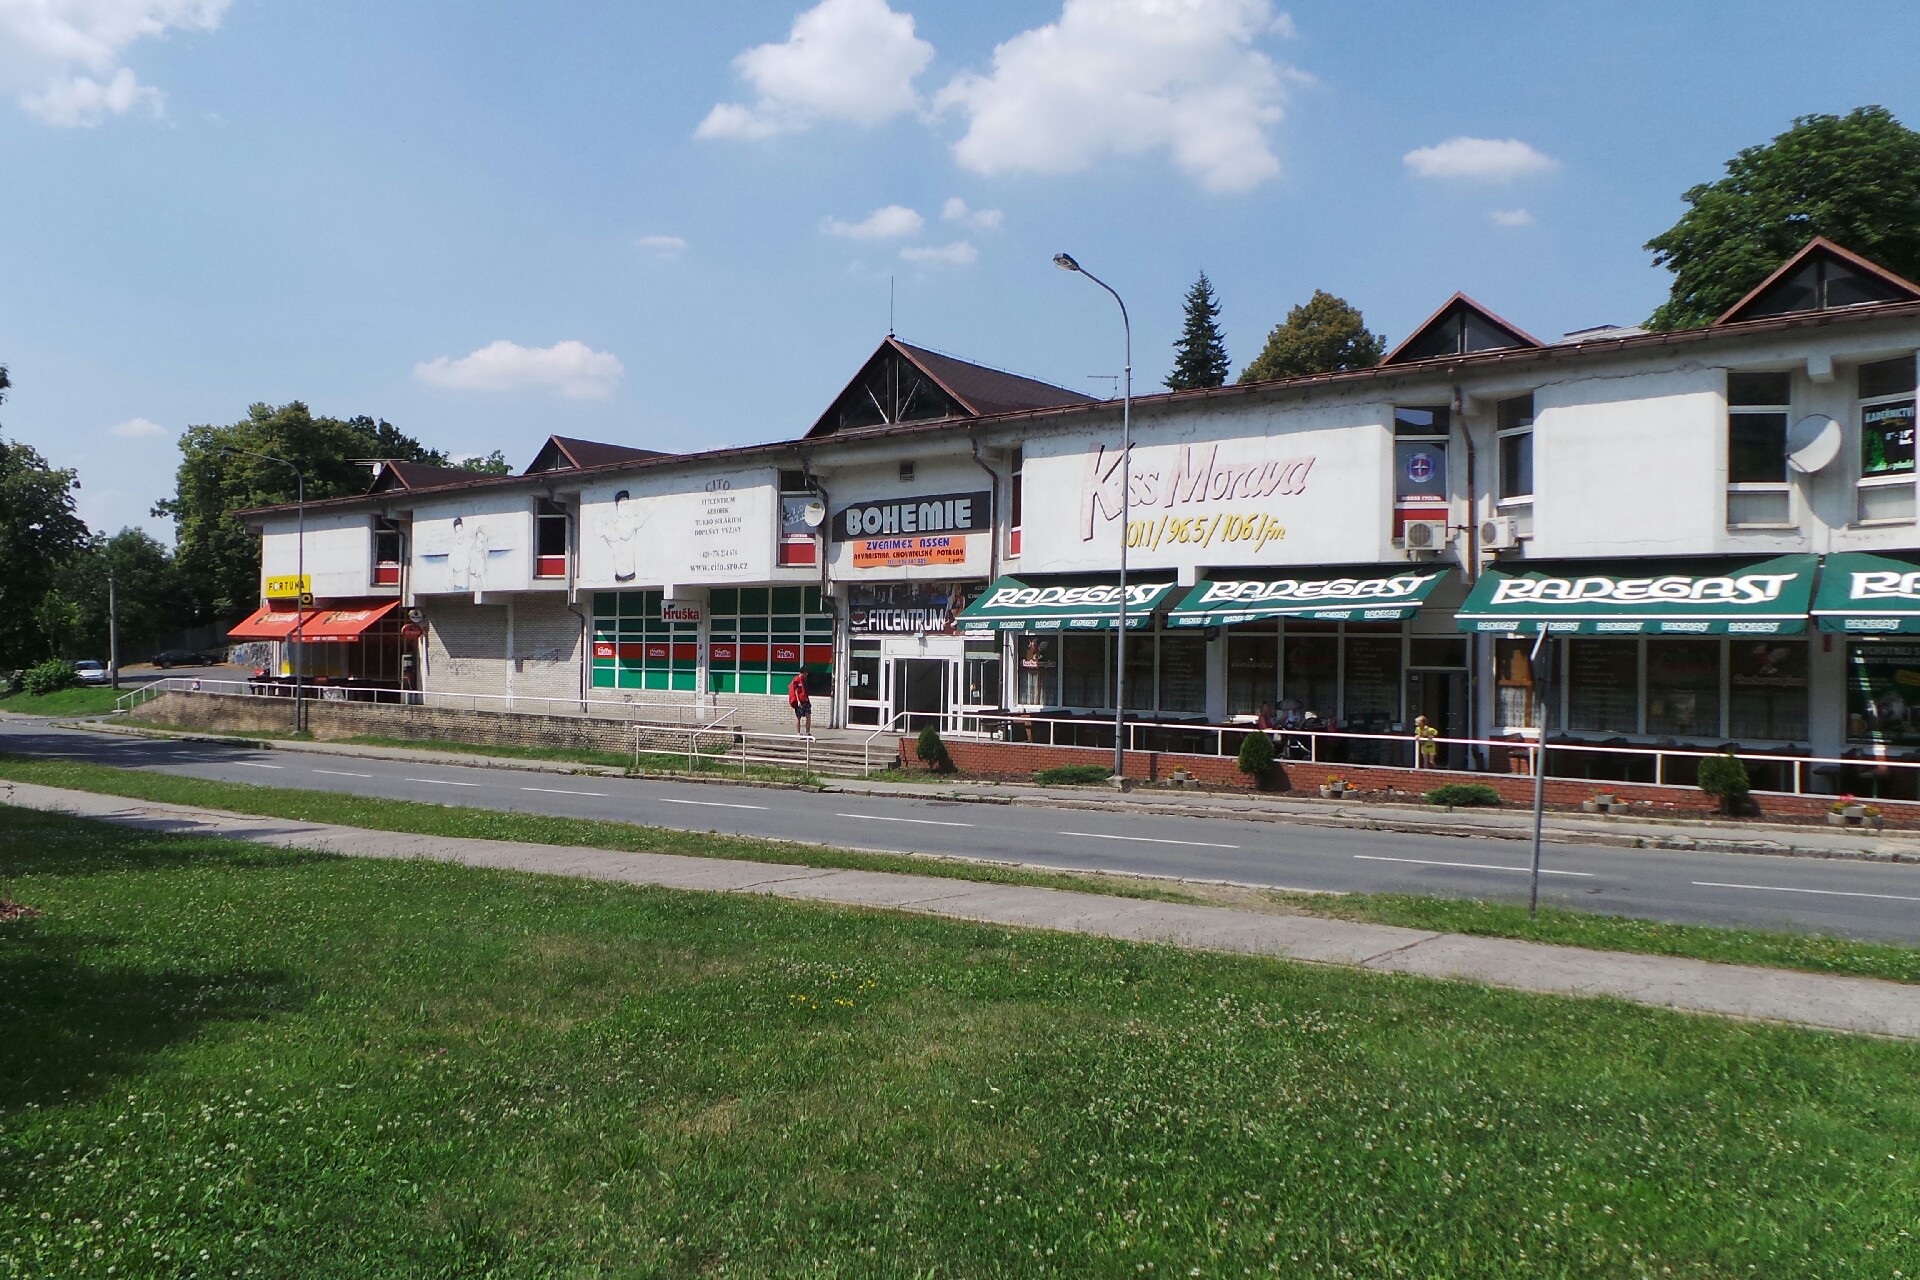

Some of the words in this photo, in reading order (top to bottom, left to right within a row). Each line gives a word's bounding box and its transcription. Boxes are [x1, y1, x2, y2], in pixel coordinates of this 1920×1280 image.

[705, 479, 731, 492] CITO
[1165, 443, 1317, 508] Morava
[846, 499, 971, 535] BOHEMIE
[919, 537, 951, 548] ASSEN
[981, 582, 1174, 609] RADEGAST
[1199, 577, 1426, 603] RADEGAST
[1490, 575, 1798, 605] RADEGAST
[663, 608, 700, 620] Hruška
[869, 608, 945, 631] FITCENTRUM
[1844, 619, 1902, 630] RADEGAST
